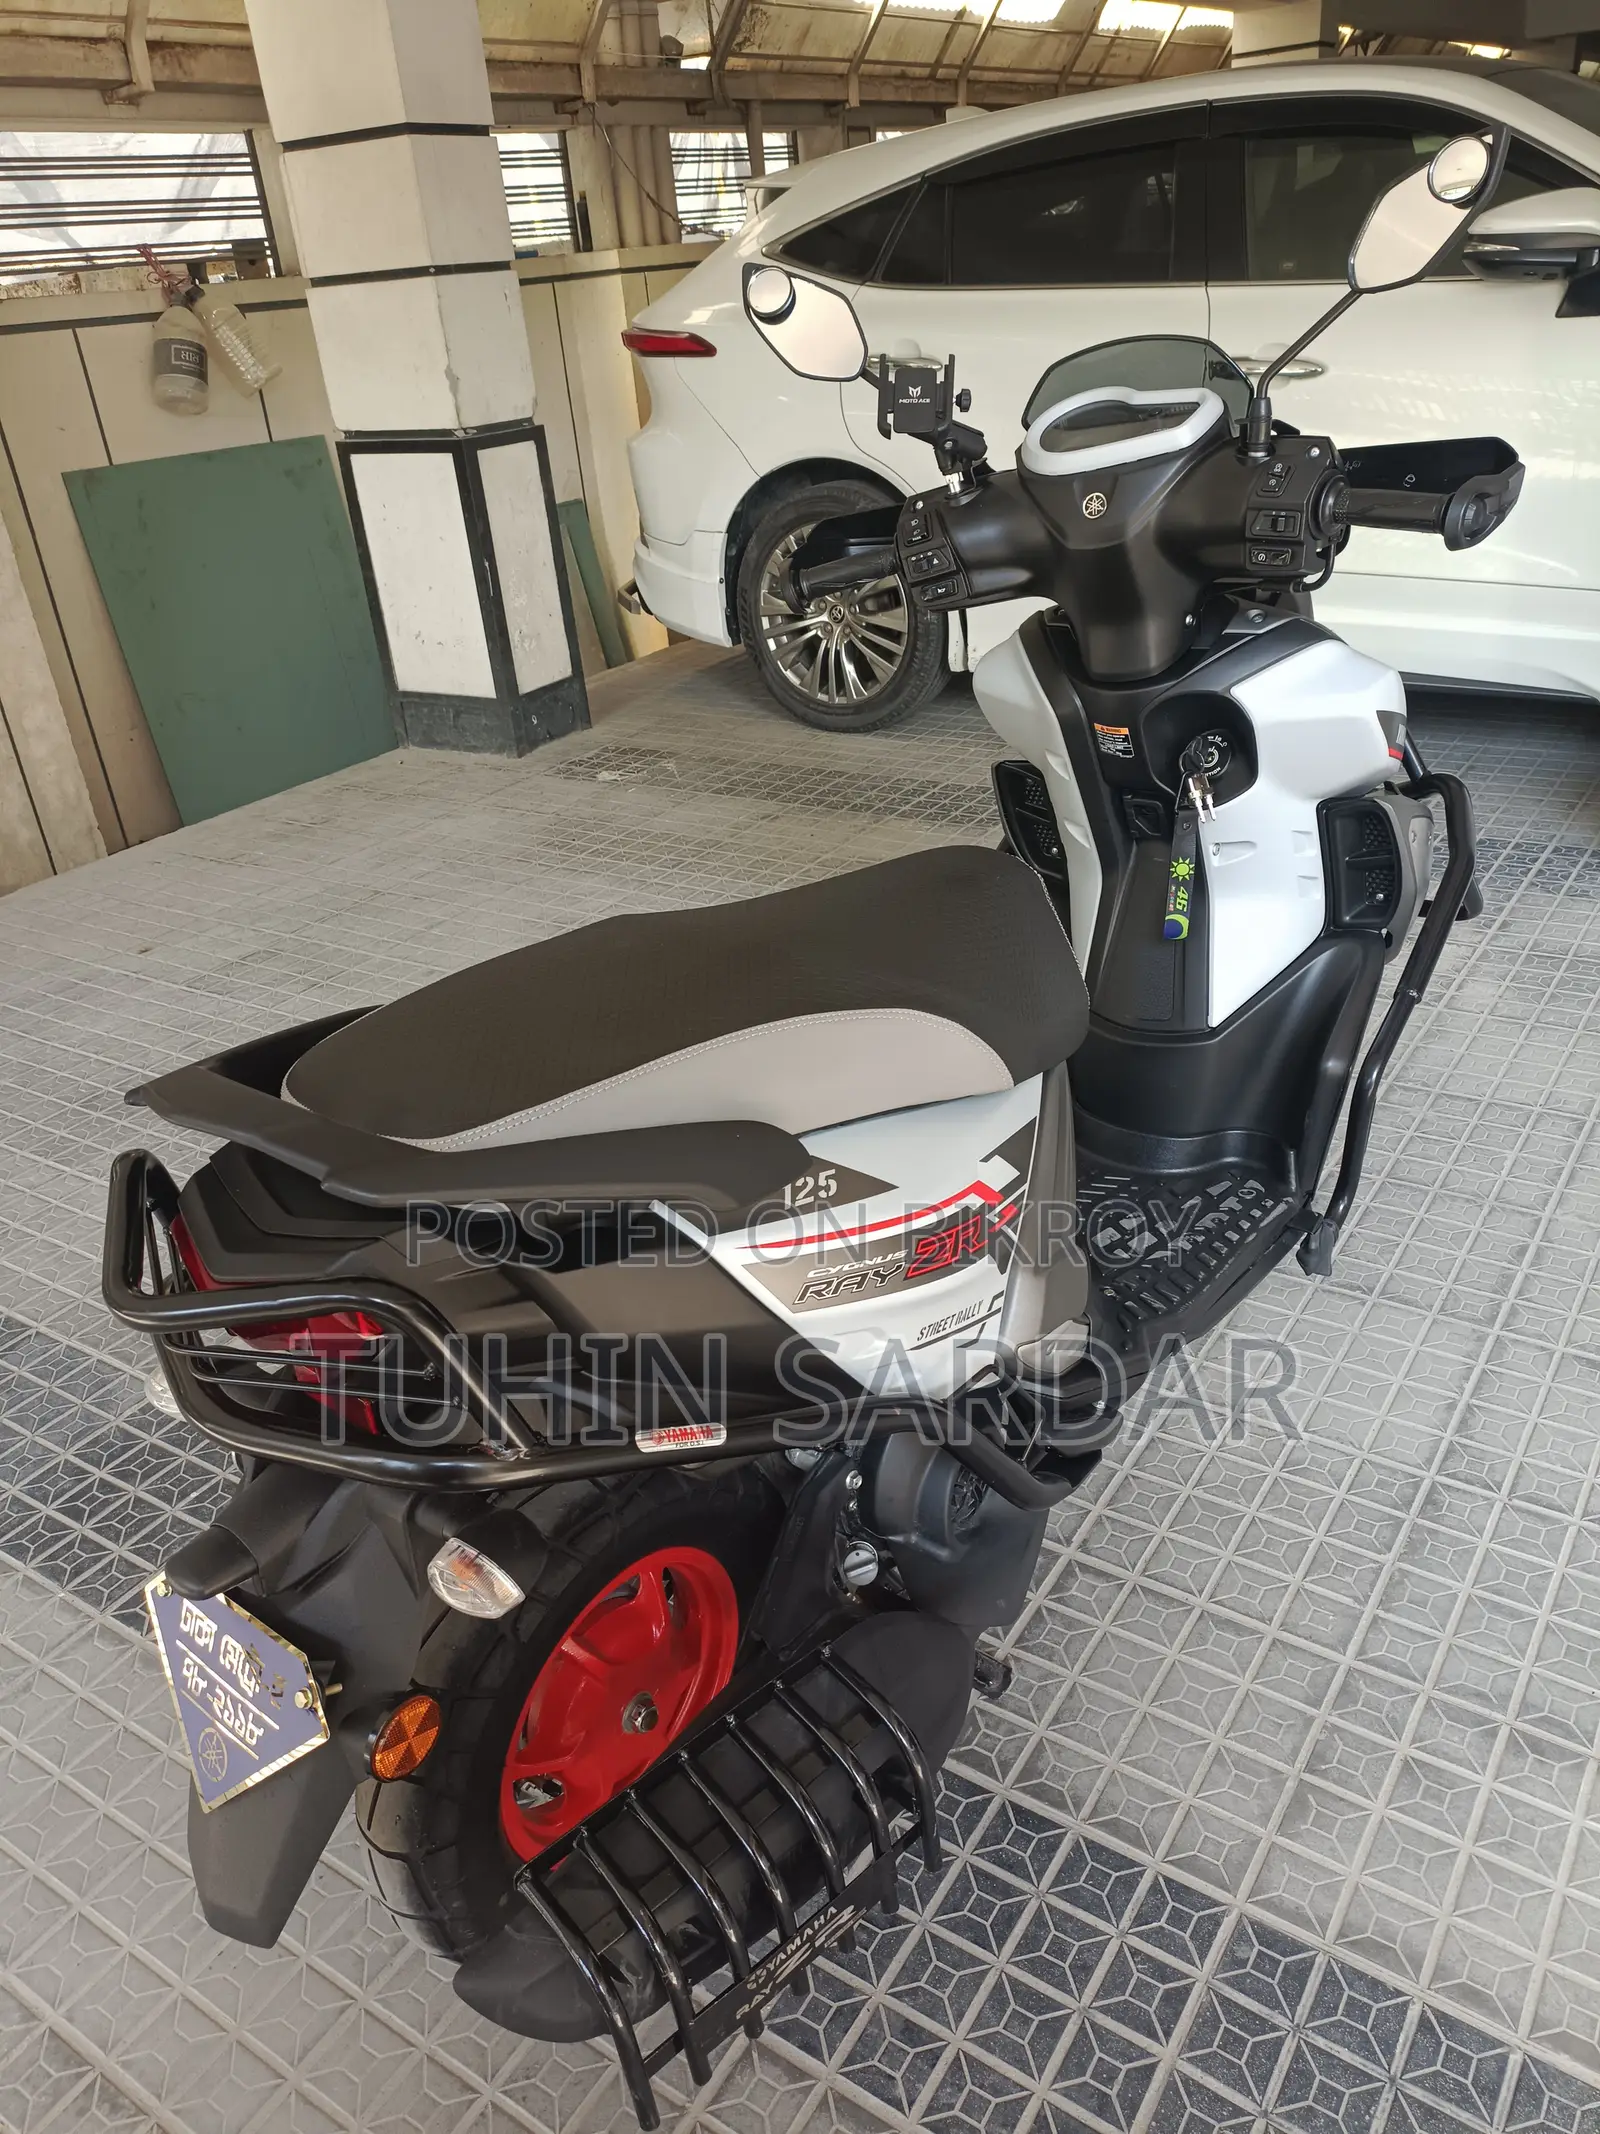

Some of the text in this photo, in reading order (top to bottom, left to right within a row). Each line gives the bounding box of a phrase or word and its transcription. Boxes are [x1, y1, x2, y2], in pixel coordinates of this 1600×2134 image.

[1176, 886, 1190, 912] 46
[783, 1168, 838, 1211] 125
[793, 1214, 989, 1306] RAY ZR
[806, 1249, 909, 1279] CYGNUS
[916, 1300, 984, 1342] STREET RALLY
[663, 1425, 714, 1443] YAMAHA
[179, 1597, 219, 1654] ঢাকা
[765, 1906, 838, 1971] YAMAHA
[734, 1981, 775, 2020] RAY
